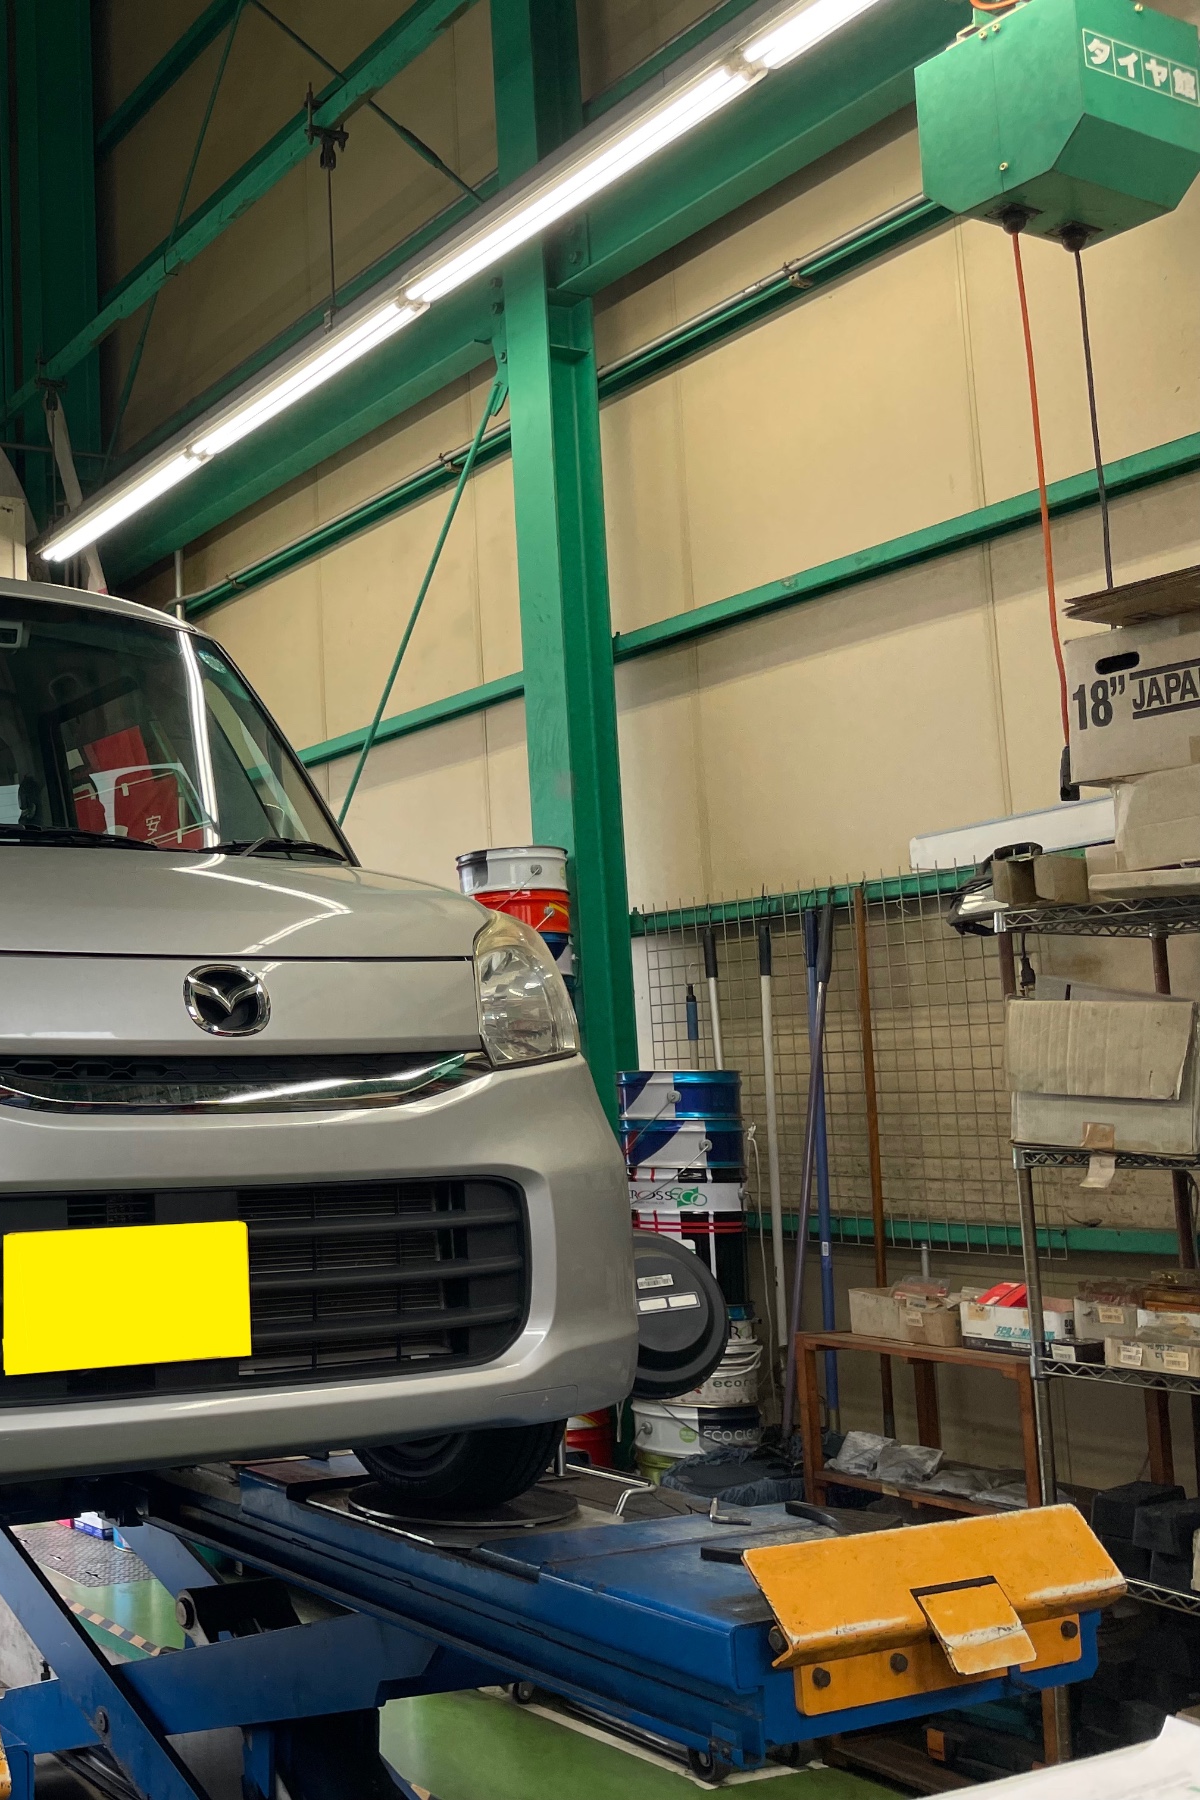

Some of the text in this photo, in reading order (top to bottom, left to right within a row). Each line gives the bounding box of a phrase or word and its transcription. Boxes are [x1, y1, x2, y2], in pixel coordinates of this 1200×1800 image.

[1087, 37, 1196, 100] タイヤ館
[1132, 668, 1200, 711] JAPA
